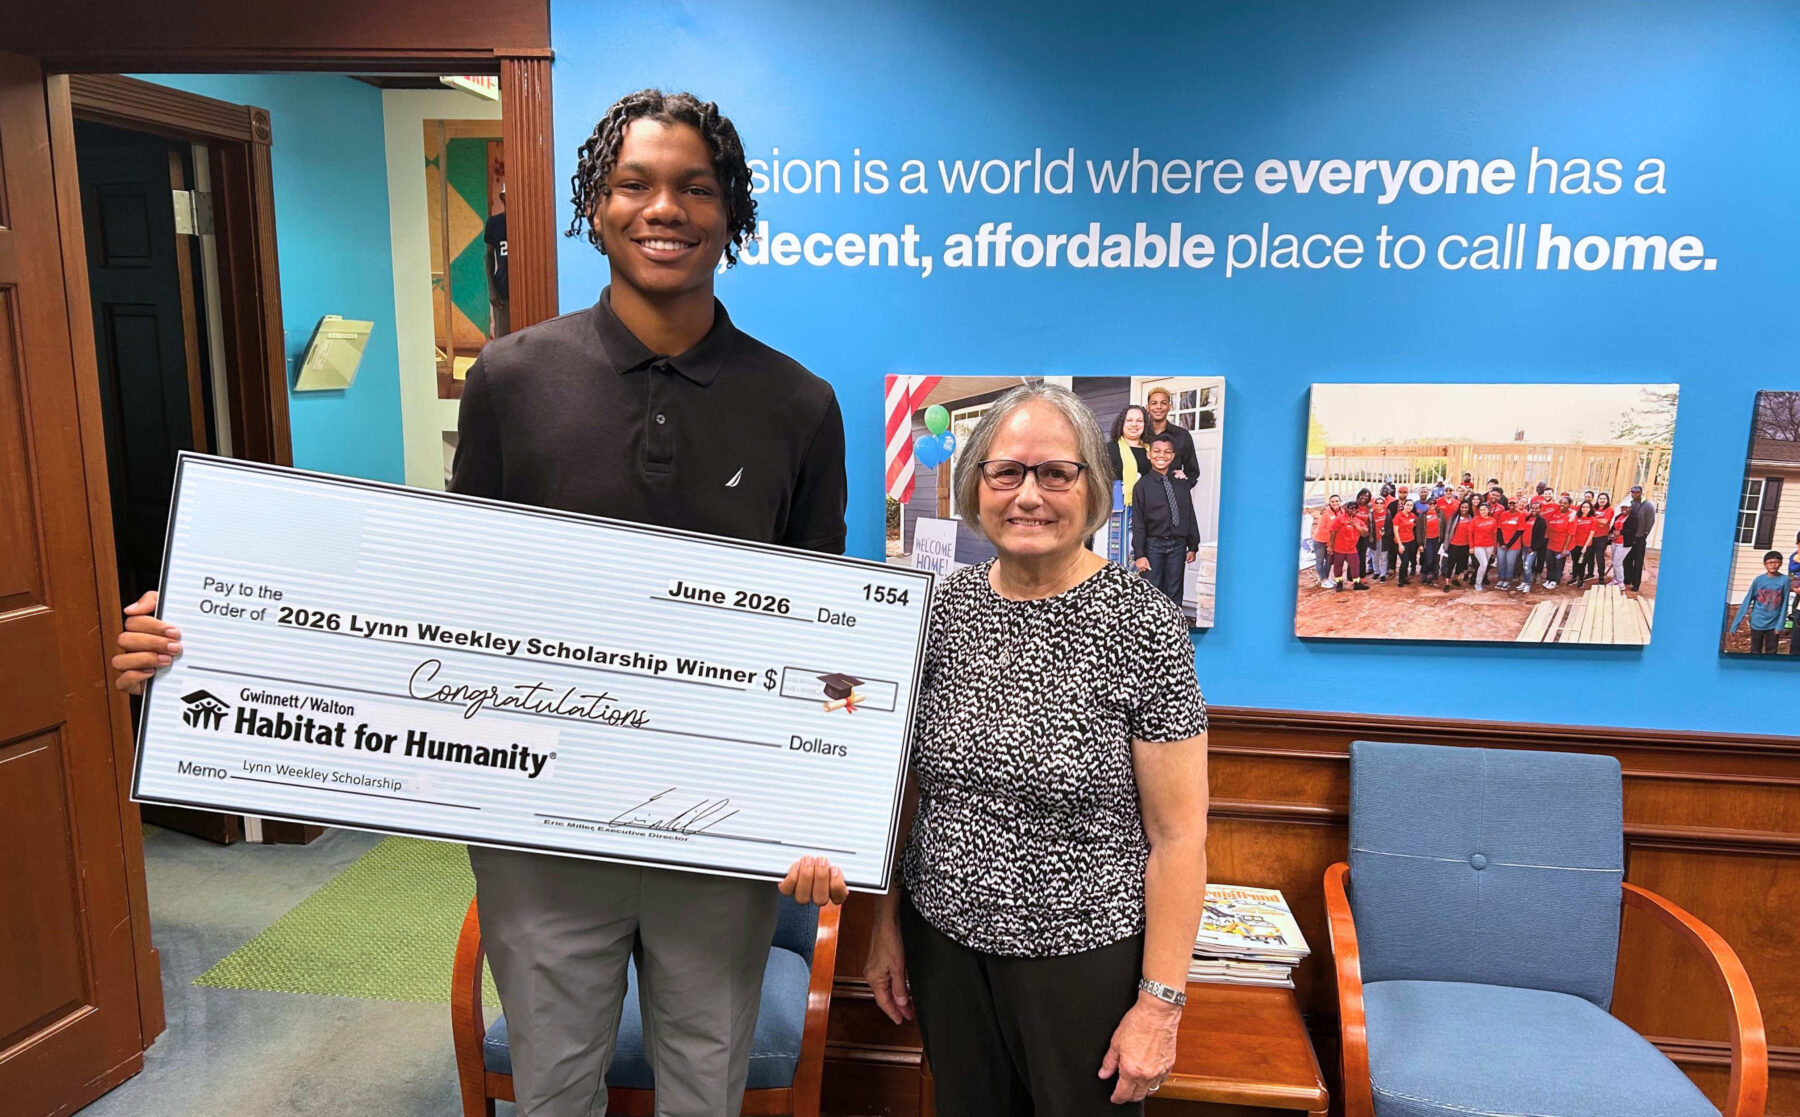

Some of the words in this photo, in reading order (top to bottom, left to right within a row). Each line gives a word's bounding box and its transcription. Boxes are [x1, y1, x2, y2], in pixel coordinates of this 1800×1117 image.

[853, 147, 890, 194] is
[899, 159, 929, 194] a
[937, 147, 1074, 195] world
[1086, 147, 1244, 195] where
[1254, 158, 1516, 204] everyone
[1527, 146, 1623, 195] has
[1633, 158, 1667, 195] a
[739, 220, 933, 278] decent,
[943, 222, 1215, 269] affordable
[1225, 222, 1364, 278] place
[1375, 224, 1426, 270] to
[1437, 223, 1526, 270] call
[1535, 223, 1718, 271] home.
[915, 537, 952, 558] WELCOME
[916, 552, 949, 577] HOME!
[203, 576, 235, 597] Pay
[239, 582, 253, 597] to
[258, 585, 283, 601] the
[668, 581, 726, 604] June
[733, 590, 791, 615] 2026
[817, 607, 857, 628] Date
[863, 583, 910, 607] 1554
[199, 599, 246, 618] Order
[249, 607, 267, 621] of
[278, 606, 341, 631] 2026
[350, 614, 409, 638] Lynn
[418, 622, 521, 656] Weekley
[526, 637, 668, 676] Scholarship
[676, 657, 758, 684] Winner
[763, 668, 778, 692] $
[409, 658, 650, 729] Congratulations
[234, 706, 346, 748] Habitat
[353, 722, 398, 755] for
[789, 735, 848, 757] Dollars
[177, 760, 228, 780] Memo
[243, 759, 272, 774] Lynn
[276, 763, 329, 783] Weekley
[331, 770, 402, 792] Scholarship
[543, 818, 564, 828] Eric
[597, 825, 646, 838] Executive
[649, 831, 689, 843] Director
